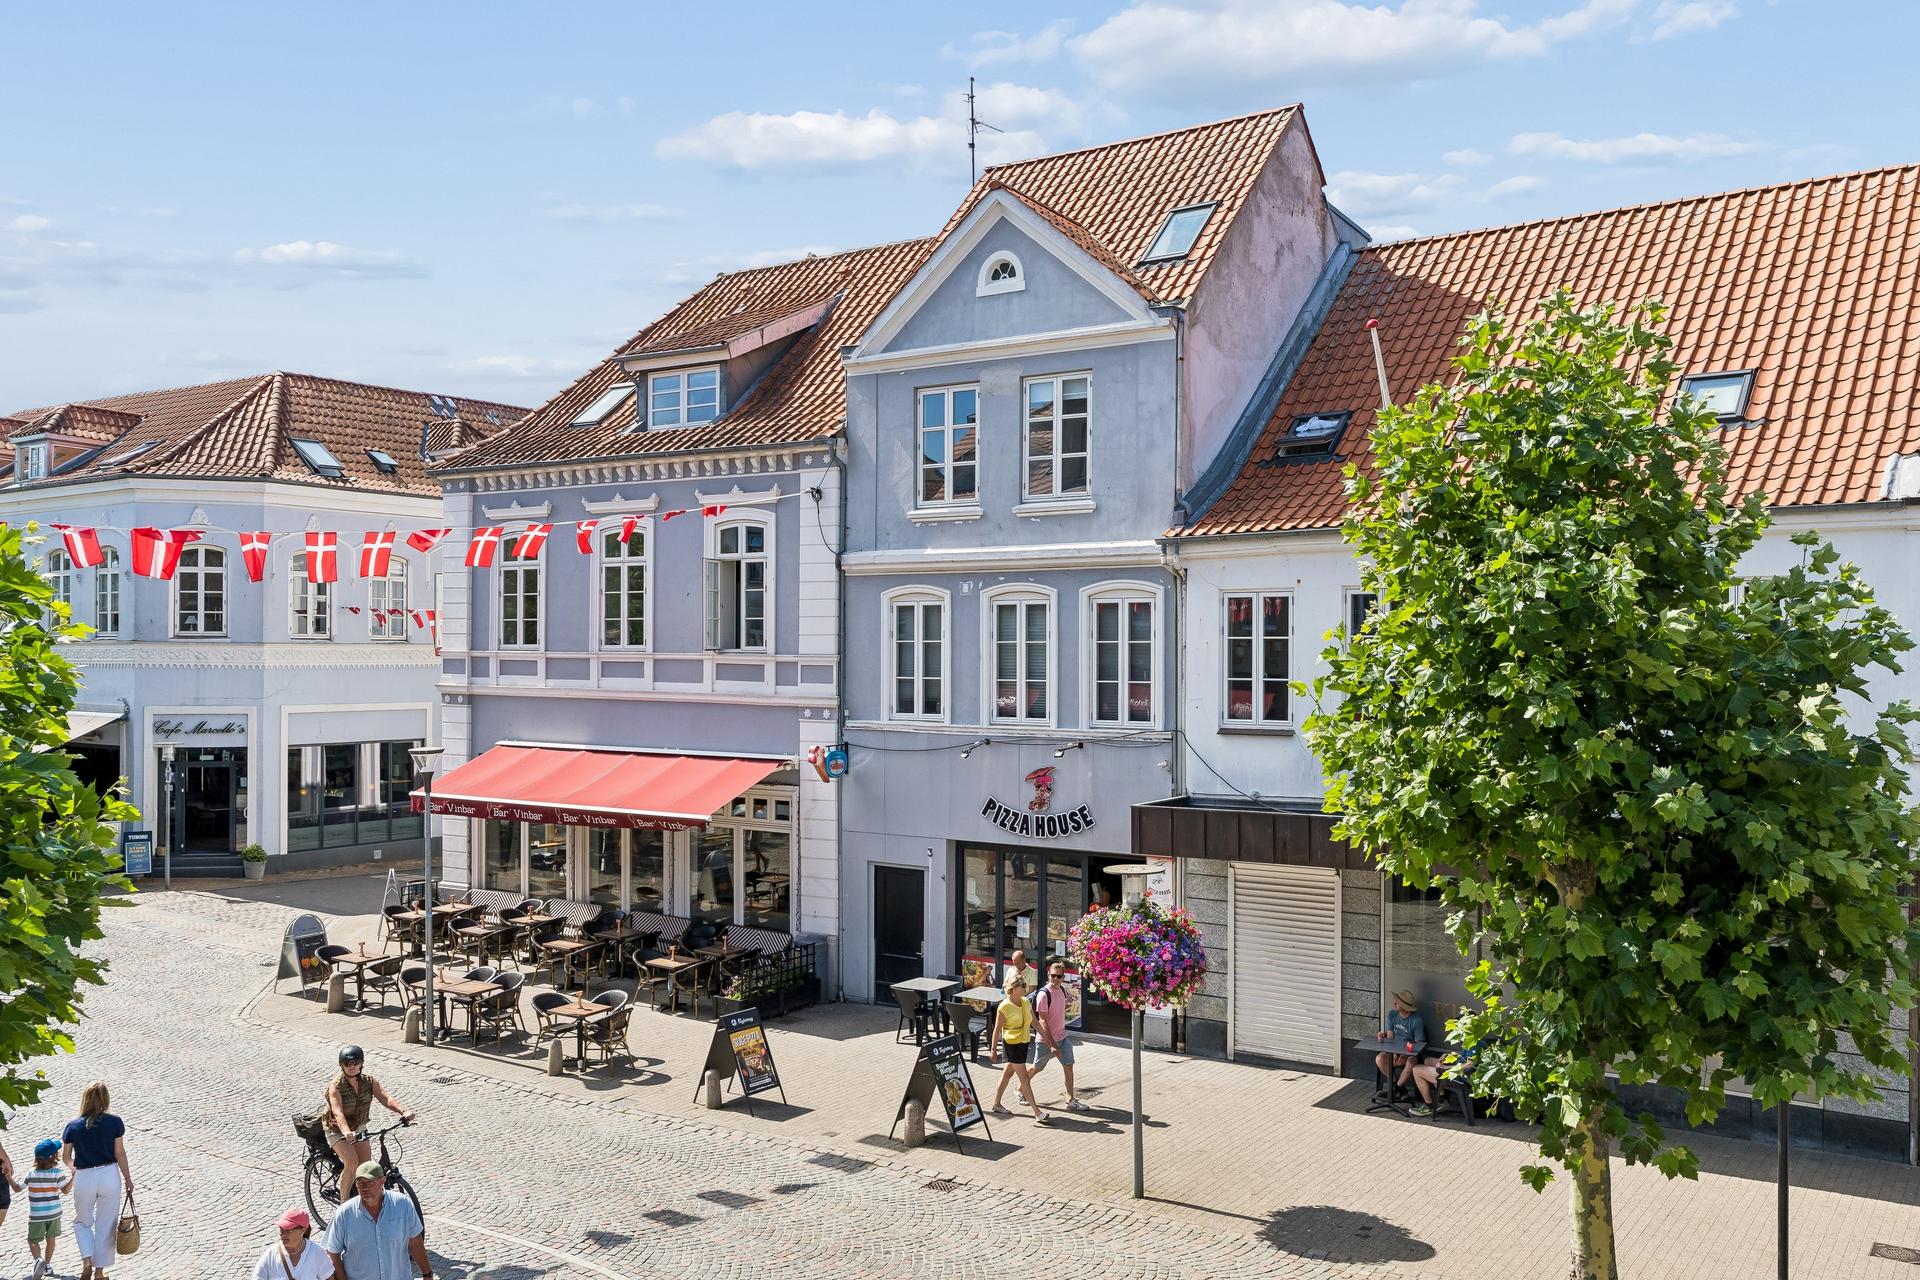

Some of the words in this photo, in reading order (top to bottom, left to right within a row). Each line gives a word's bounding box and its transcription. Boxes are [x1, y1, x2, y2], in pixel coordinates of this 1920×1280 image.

[154, 720, 183, 739] Cafe
[185, 721, 246, 734] Marcello's
[447, 804, 476, 815] Vinbar
[514, 809, 544, 821] Vinbar
[583, 815, 617, 825] Vinbar
[980, 796, 1031, 837] PIZZA
[1034, 803, 1095, 838] HOUSE
[927, 848, 933, 857] 3
[935, 1061, 949, 1070] Super
[940, 1065, 956, 1075] Burger
